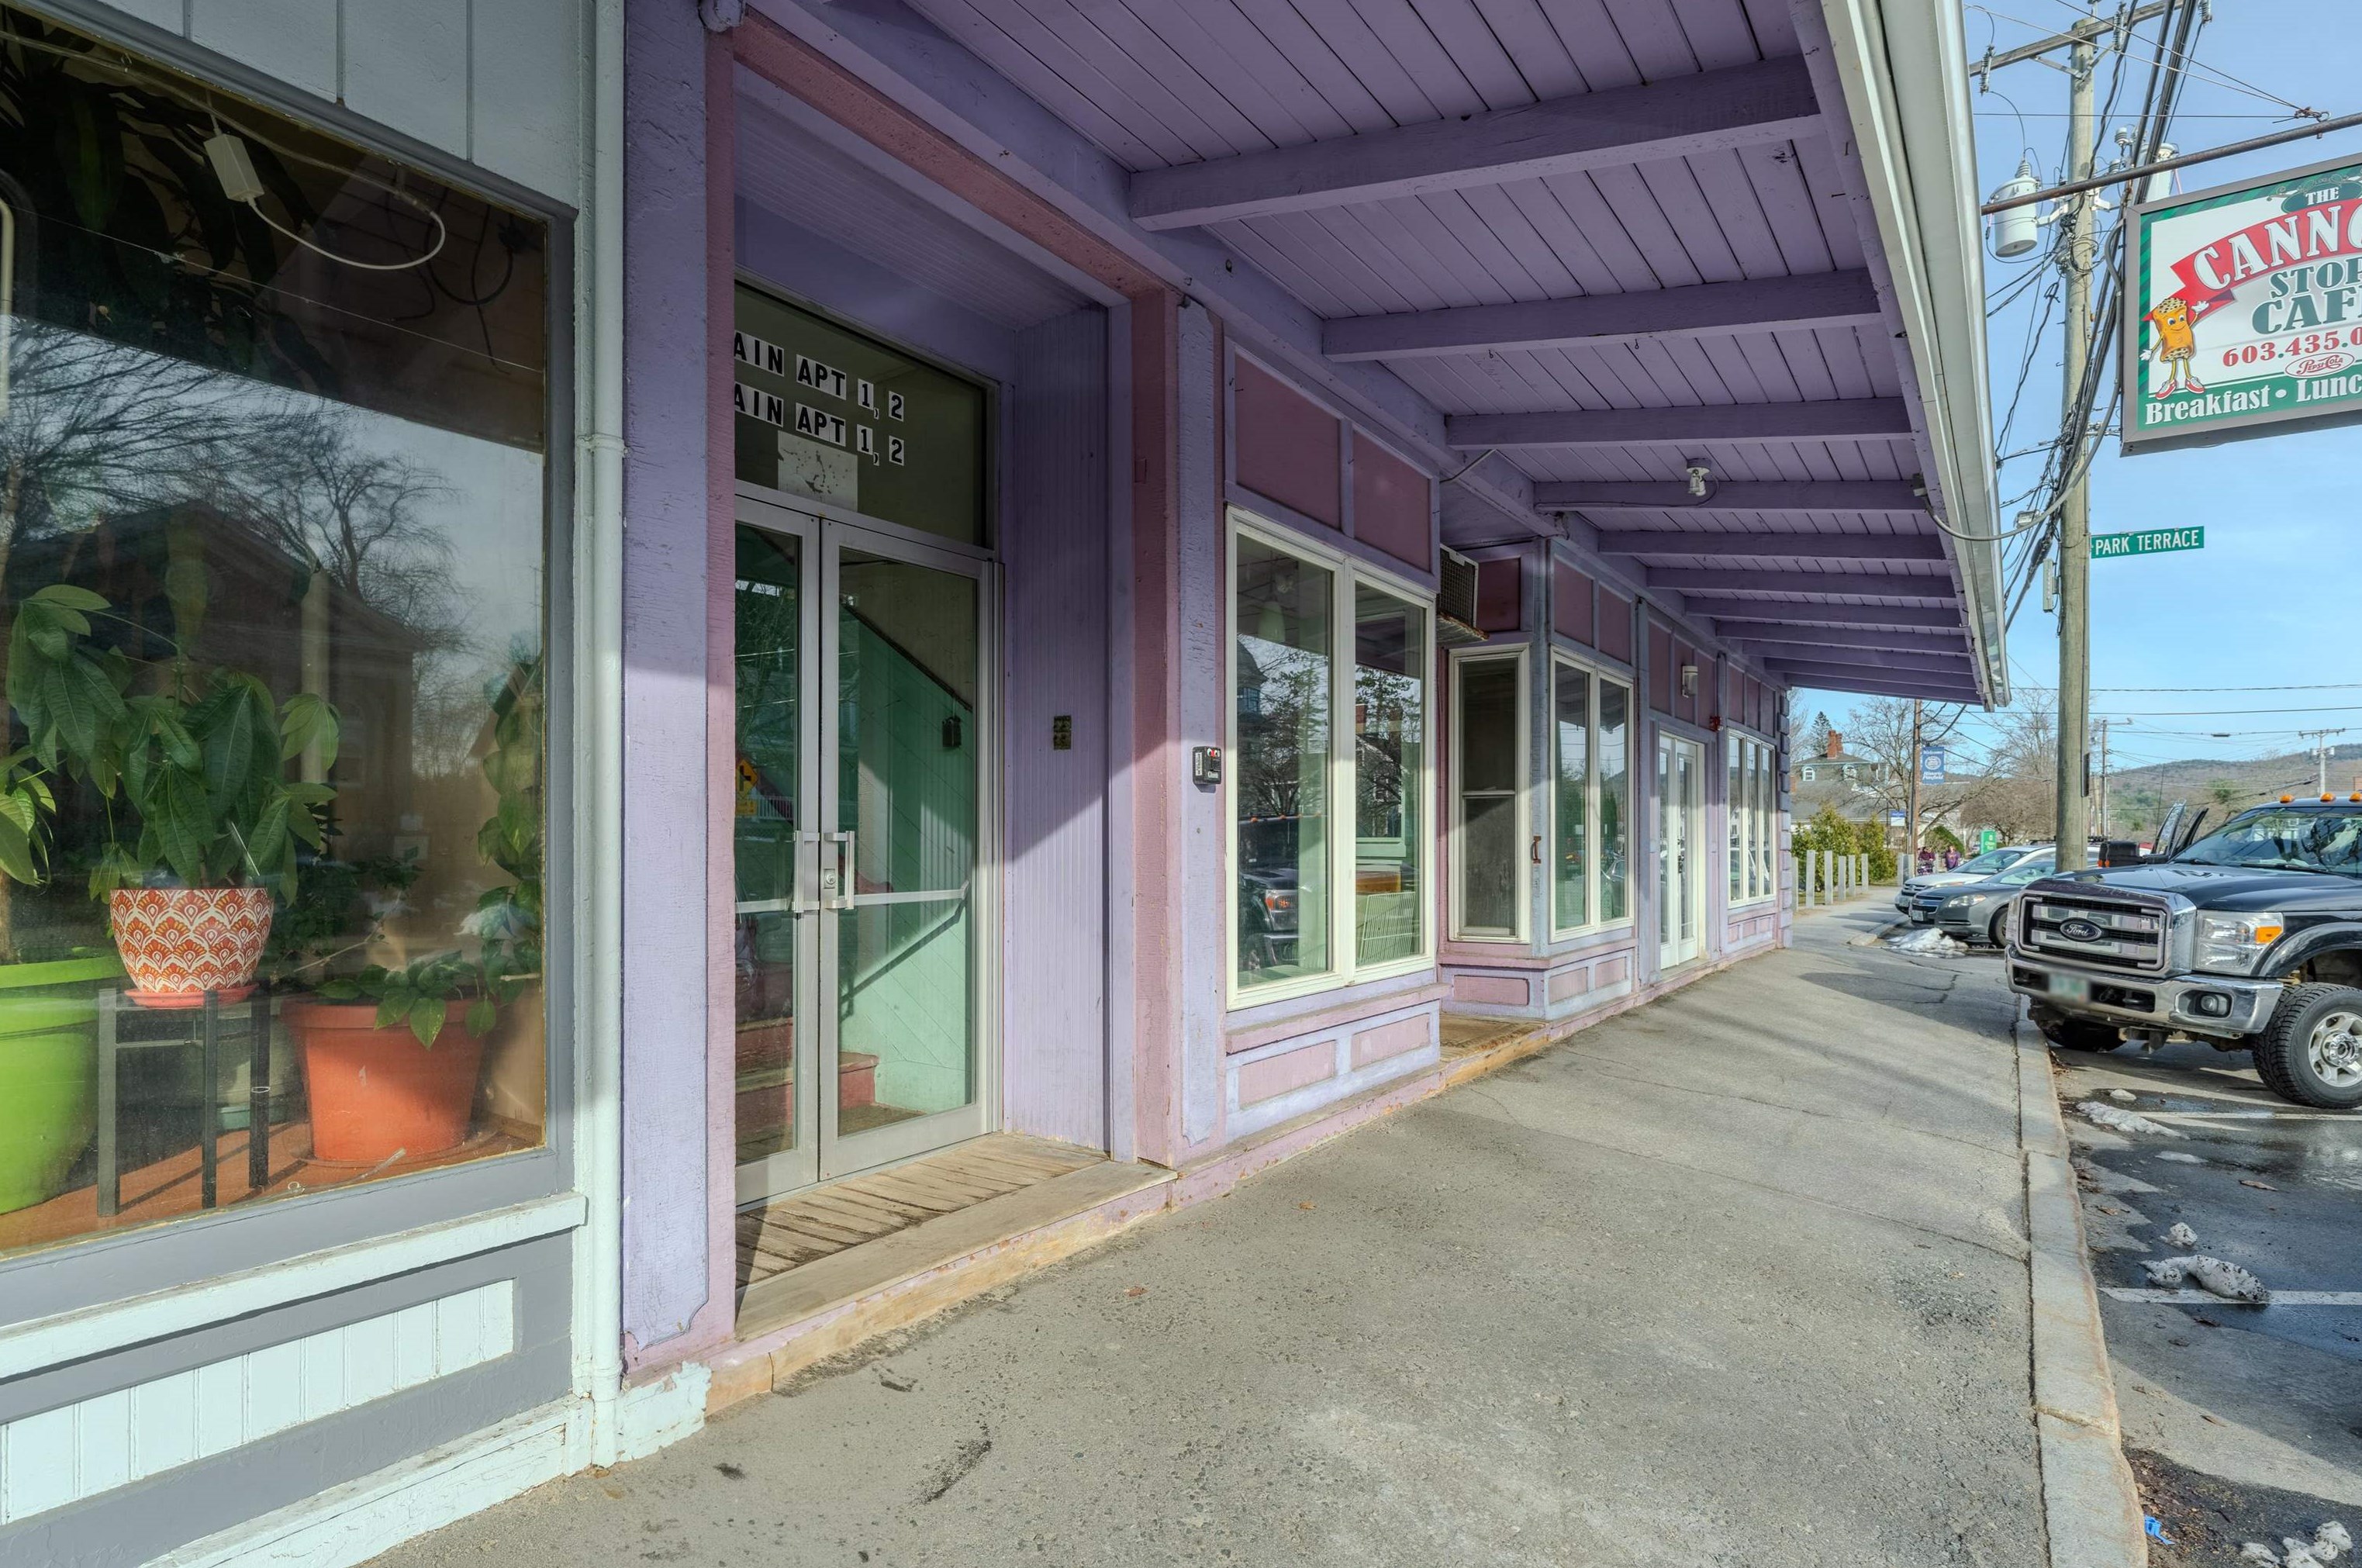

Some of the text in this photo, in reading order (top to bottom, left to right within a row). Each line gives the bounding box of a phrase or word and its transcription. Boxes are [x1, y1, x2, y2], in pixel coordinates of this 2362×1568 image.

[2305, 187, 2340, 205] THE
[2252, 285, 2362, 335] CAF
[797, 357, 846, 397] APT
[861, 382, 879, 419] 1,
[891, 394, 903, 420] 2
[2145, 385, 2270, 425] Breakfast
[797, 406, 845, 444] APT
[861, 429, 879, 464] 1,
[891, 439, 903, 464] 2
[2095, 530, 2200, 555] PARK TERRACE
[2067, 923, 2089, 937] Ford
